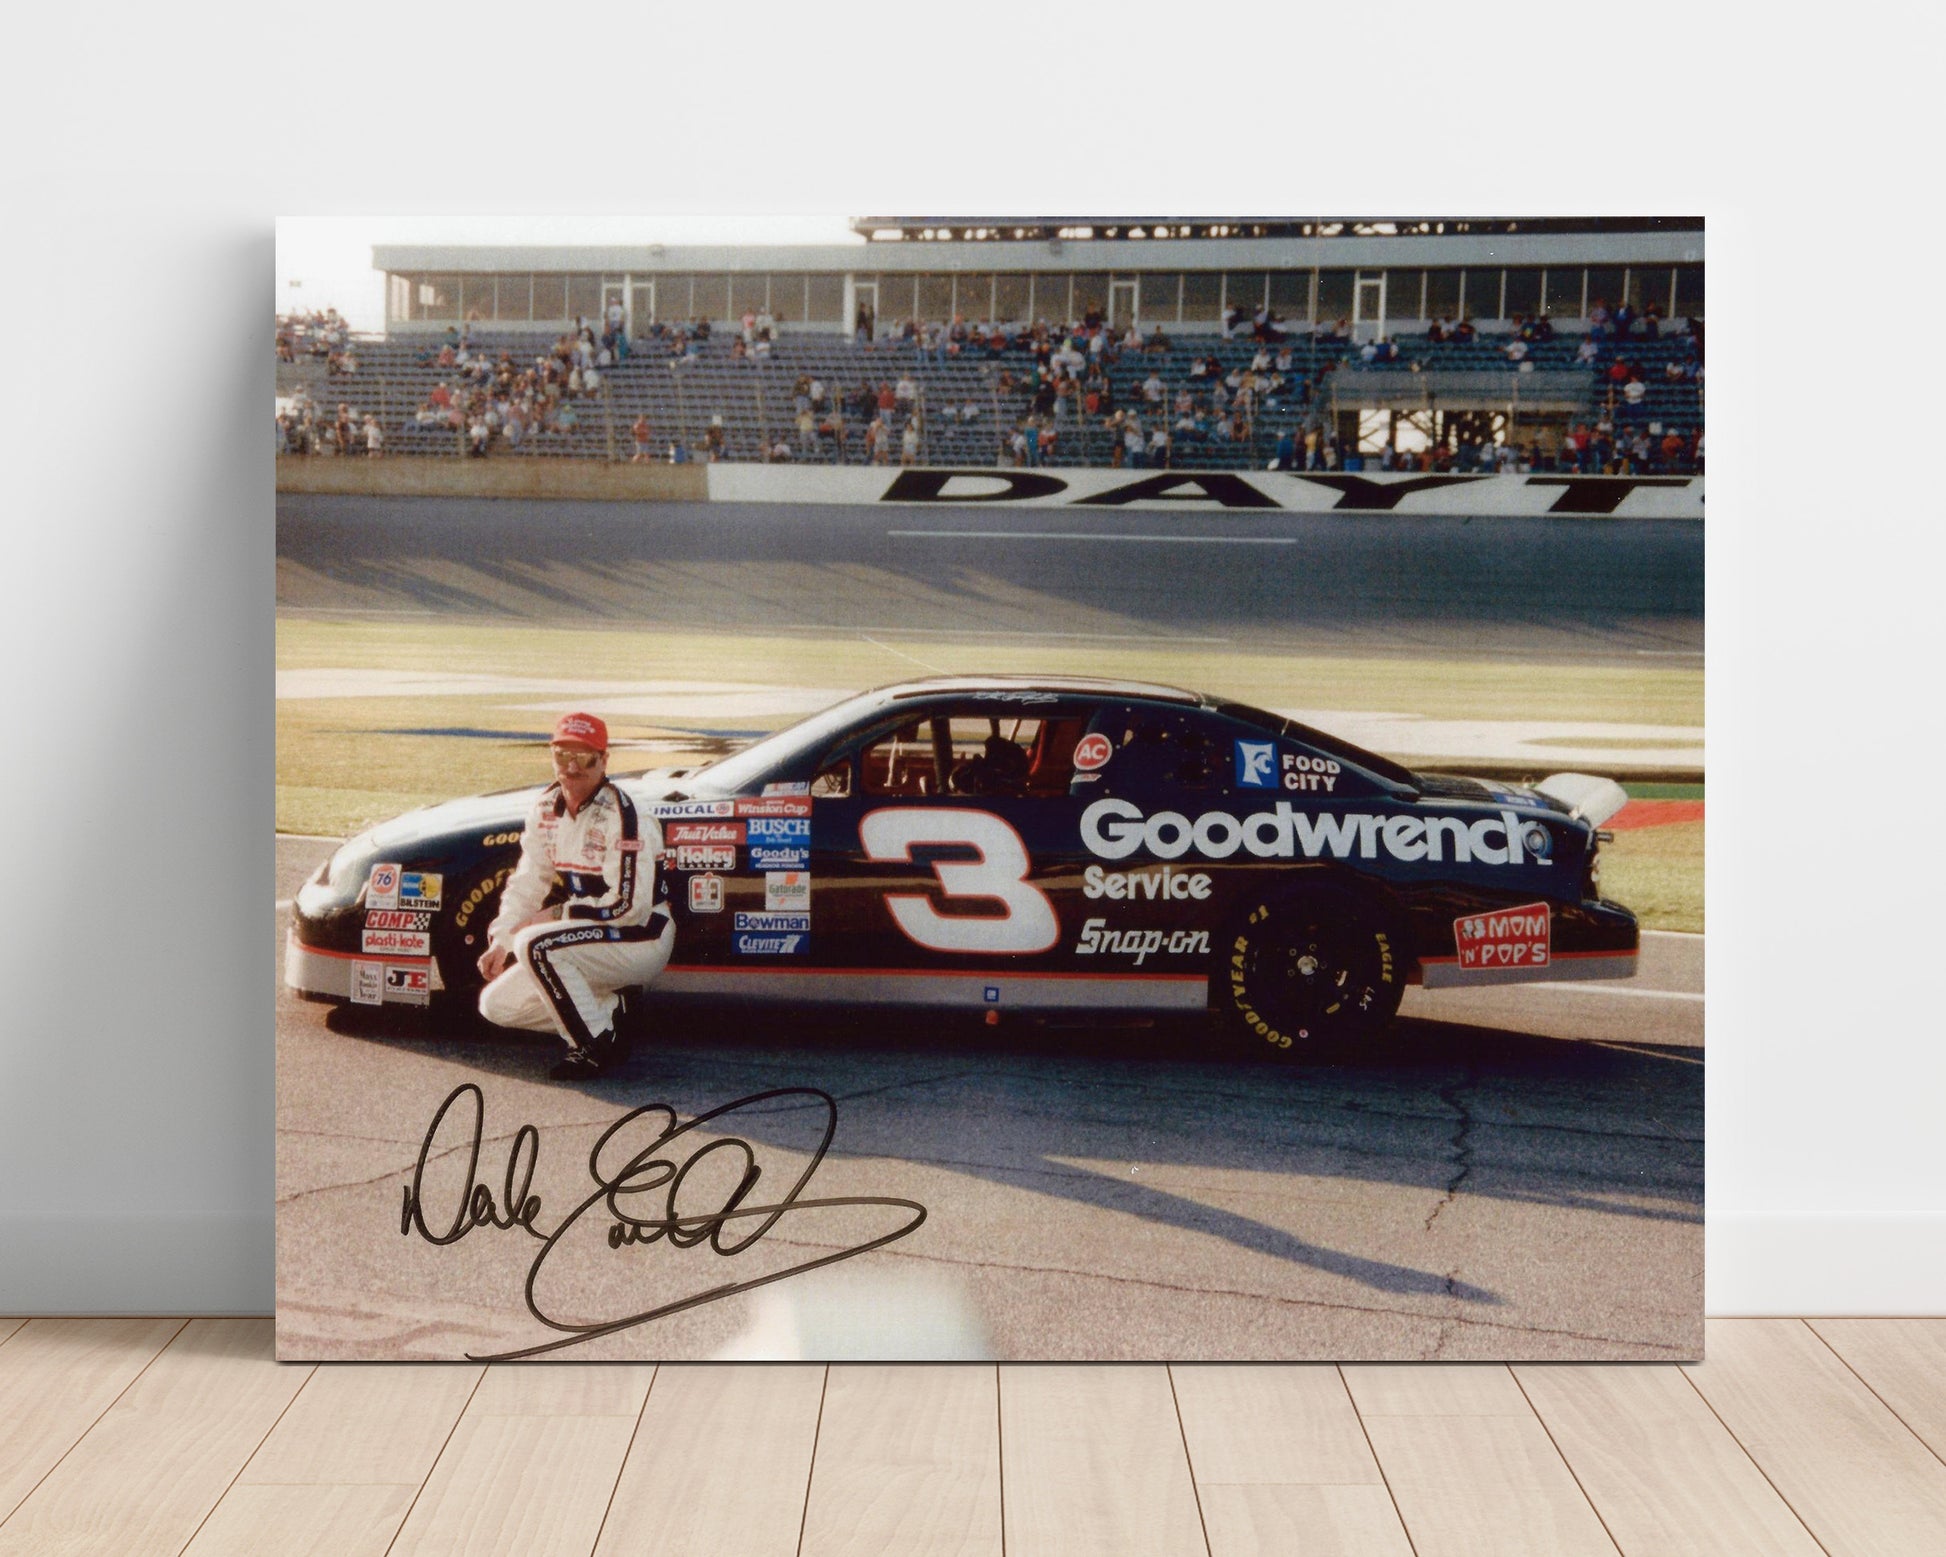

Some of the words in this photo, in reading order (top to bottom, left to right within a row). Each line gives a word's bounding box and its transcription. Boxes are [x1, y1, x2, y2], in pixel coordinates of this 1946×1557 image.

[878, 469, 1705, 513] DAYT
[1077, 744, 1107, 760] AC
[1282, 754, 1340, 774] FOOD
[1284, 772, 1336, 792] CITY
[738, 804, 784, 814] Winston
[784, 804, 809, 815] Cup
[749, 819, 810, 835] BUSCH
[1080, 798, 1553, 865] Goodwrench
[482, 832, 520, 847] GOO
[680, 846, 733, 869] Holley
[751, 848, 809, 863] Goody's
[376, 872, 392, 886] 76
[858, 805, 1061, 955] 3
[1083, 865, 1212, 900] Service
[769, 884, 806, 894] Gatorade
[400, 898, 440, 908] BILSTEIN
[366, 910, 415, 928] COMP
[736, 913, 809, 929] Bowman
[1489, 915, 1546, 937] MOM
[365, 932, 424, 948] plasti-kote
[1075, 918, 1211, 965] Snap-on
[1375, 933, 1393, 983] EAGLE
[1481, 941, 1546, 964] POP'S
[387, 970, 426, 988] JE
